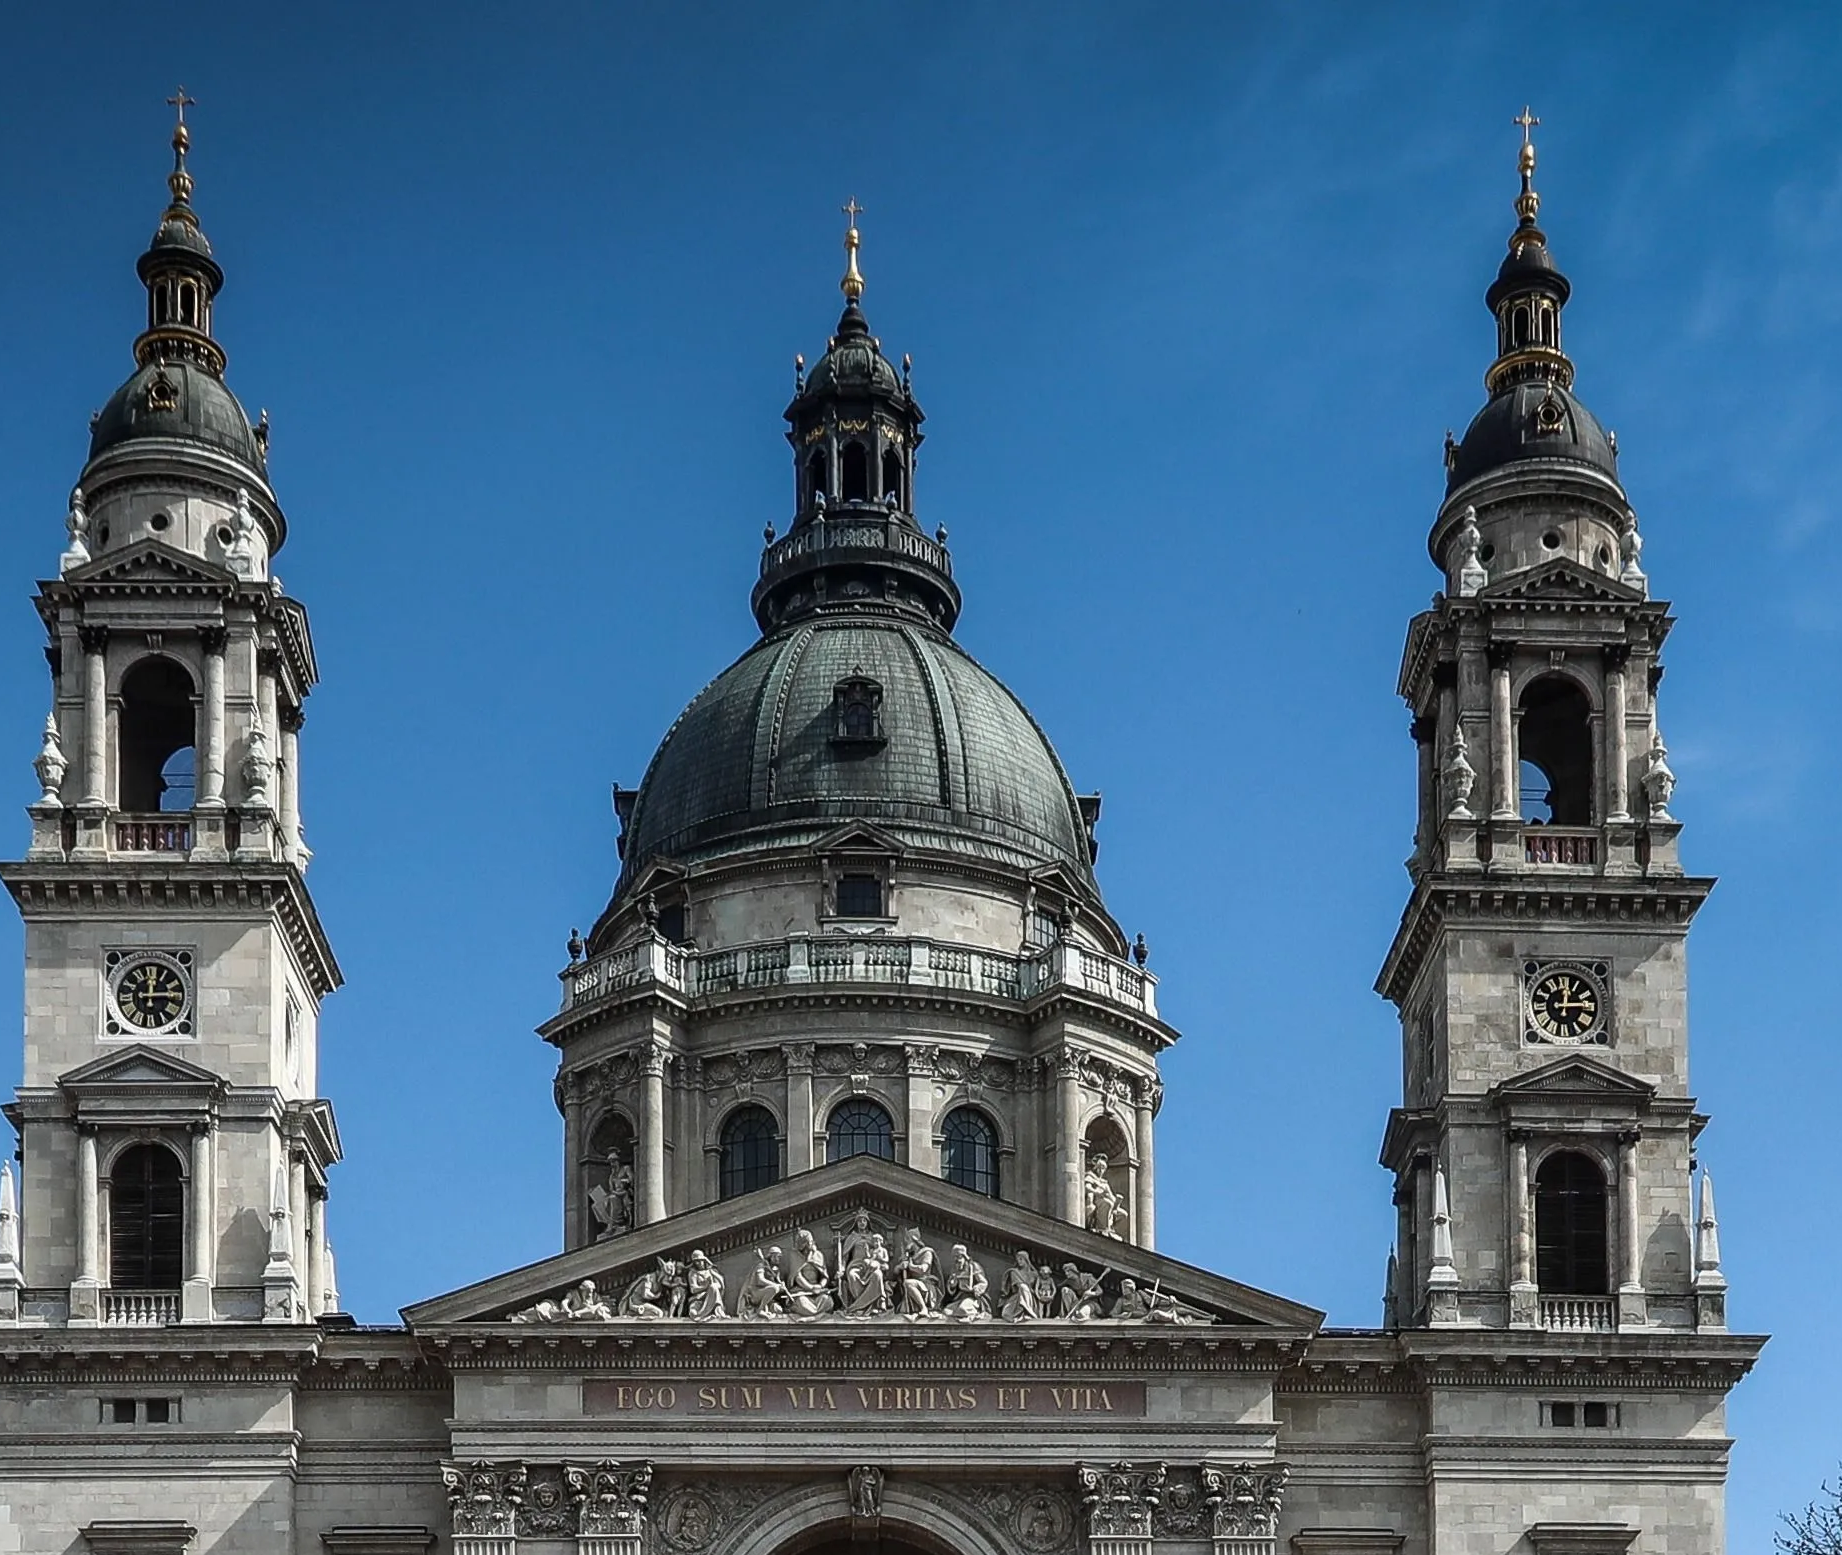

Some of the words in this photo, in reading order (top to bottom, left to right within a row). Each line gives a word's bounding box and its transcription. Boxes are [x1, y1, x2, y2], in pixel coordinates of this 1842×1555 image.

[616, 1386, 676, 1410] EGO
[698, 1386, 762, 1410] SUM
[787, 1386, 837, 1410] VIA
[857, 1387, 978, 1411] VERITAS
[997, 1388, 1031, 1411] ET
[1050, 1387, 1114, 1411] VITA
